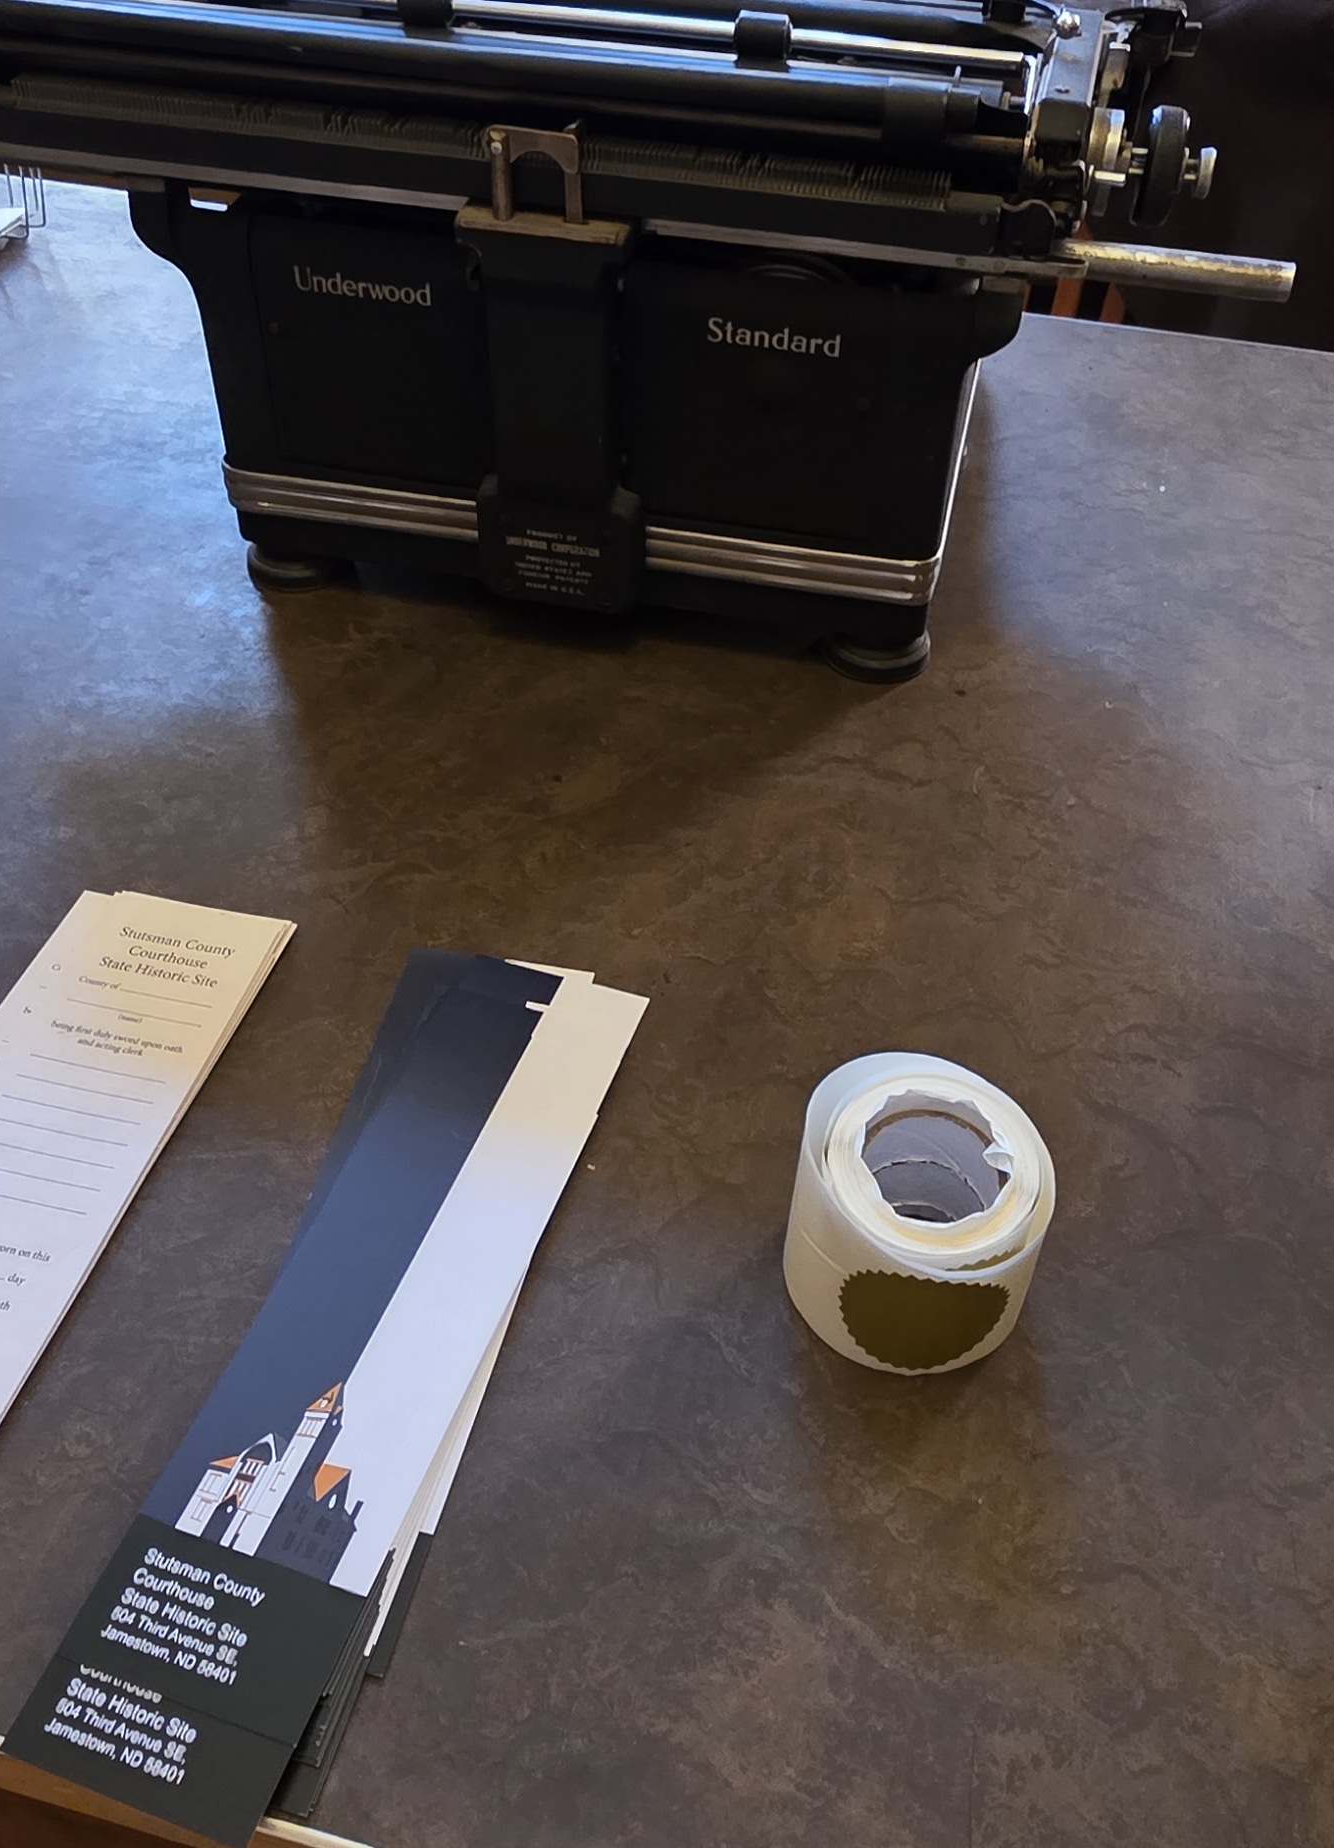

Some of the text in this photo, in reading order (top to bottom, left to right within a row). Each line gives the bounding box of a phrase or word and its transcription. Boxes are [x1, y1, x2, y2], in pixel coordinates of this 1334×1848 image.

[293, 264, 432, 306] Underwood
[707, 317, 841, 358] Standard
[119, 926, 236, 959] Stutsman County
[128, 945, 208, 969] Courthouse
[78, 975, 122, 990] County of
[98, 956, 218, 988] State Historic Site
[18, 1249, 31, 1258] on
[32, 1250, 51, 1262] this
[7, 1273, 26, 1287] day
[133, 1567, 215, 1610] Courthouse
[144, 1547, 265, 1607] Stutsman County
[121, 1587, 248, 1647] State Historic Site
[138, 1614, 169, 1639] Third
[167, 1628, 215, 1656] Avenue
[100, 1624, 170, 1663] Jamestown,
[173, 1650, 197, 1671] ND
[67, 1677, 196, 1743] State Historic Site
[83, 1707, 117, 1734] Third
[114, 1722, 162, 1753] Avenue
[44, 1718, 116, 1760] Jamestown,
[120, 1746, 144, 1768] ND
